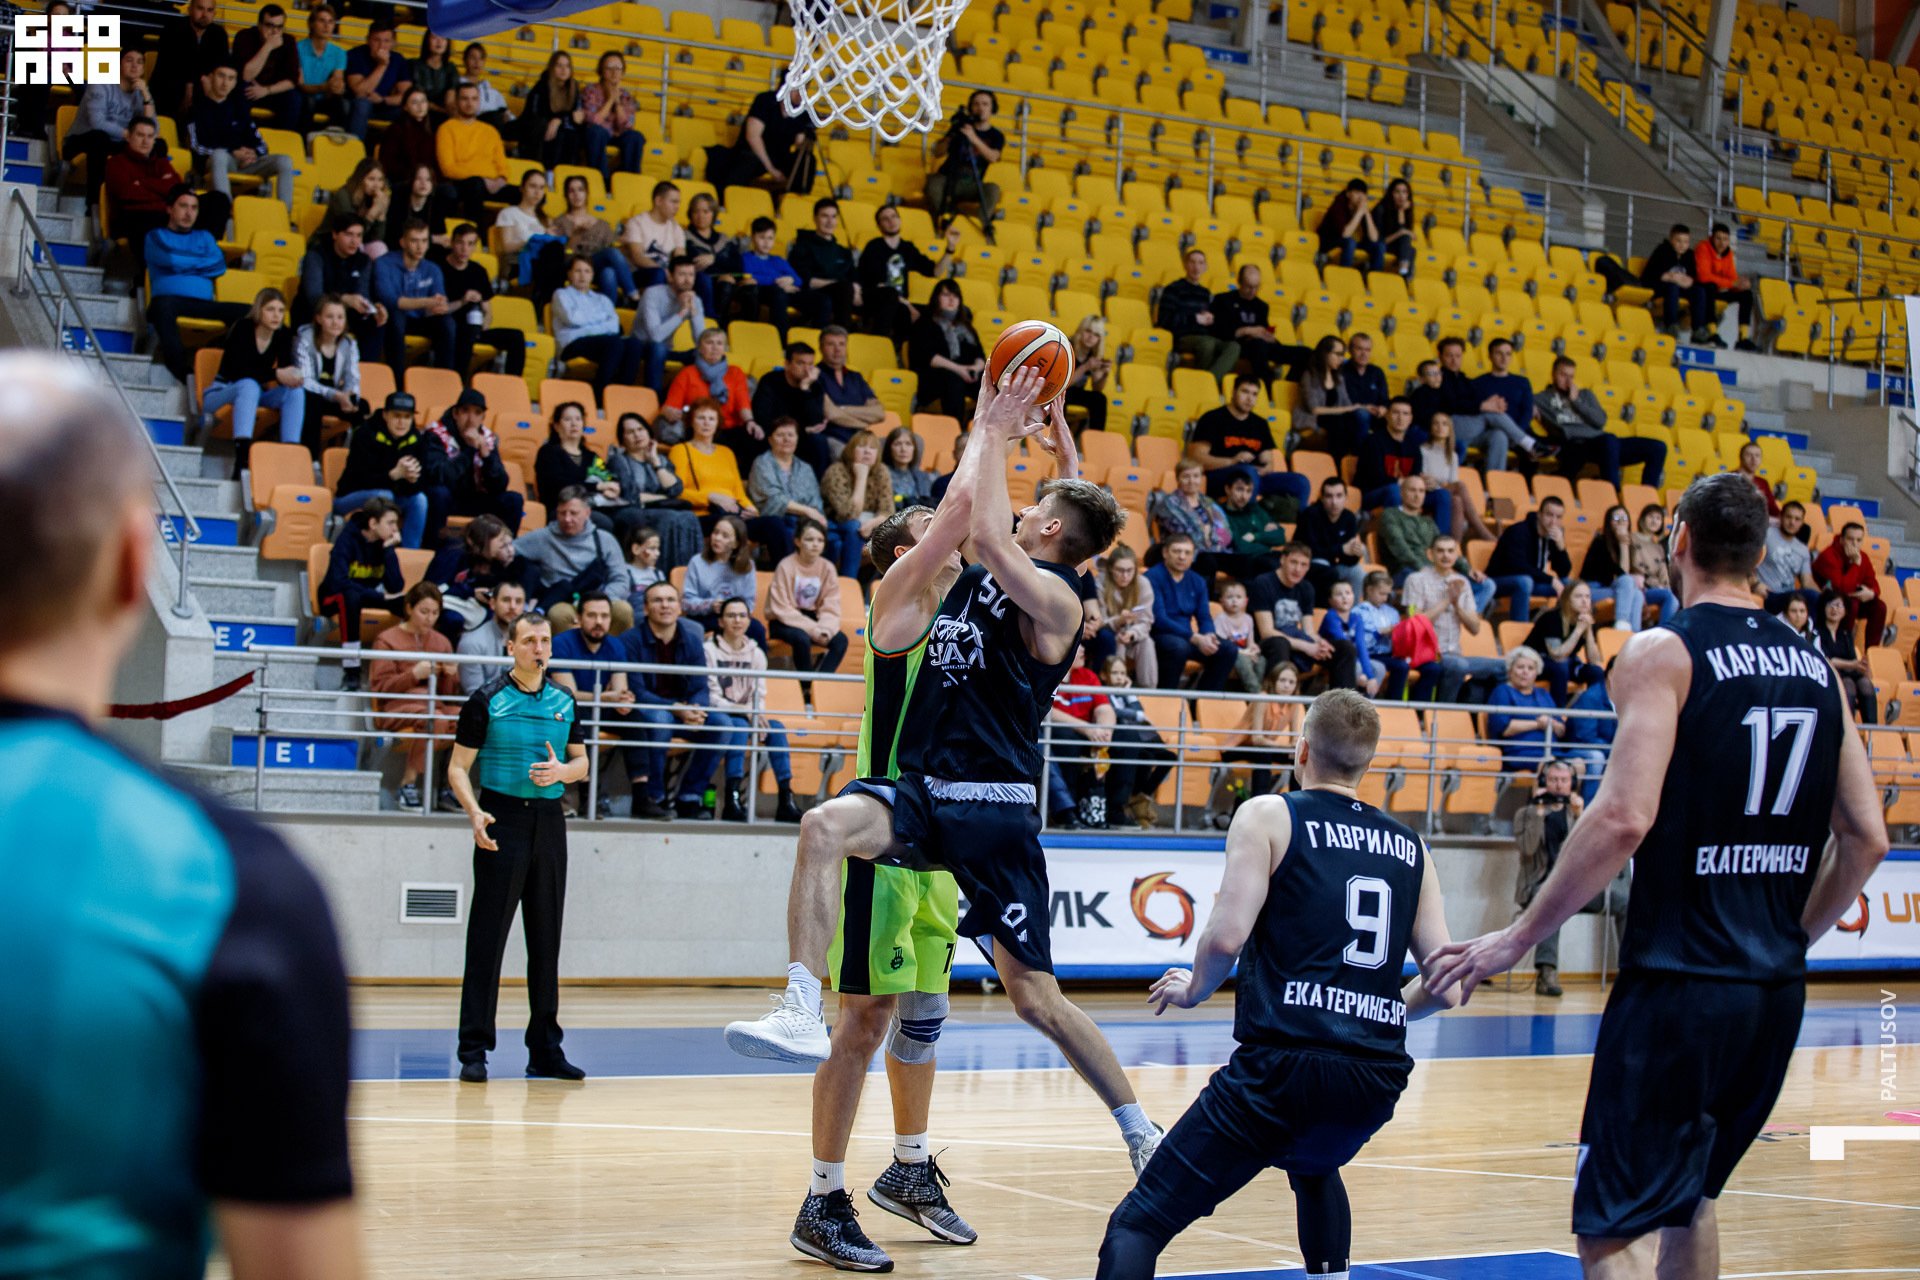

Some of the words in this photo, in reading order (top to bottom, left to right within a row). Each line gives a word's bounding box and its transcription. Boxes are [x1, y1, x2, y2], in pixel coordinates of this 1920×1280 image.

[215, 626, 231, 647] E
[242, 627, 256, 648] 2
[1706, 643, 1829, 688] КАРАУЛОВ
[276, 742, 291, 763] E
[305, 743, 315, 764] 1
[1741, 706, 1818, 816] 17
[1305, 820, 1417, 868] ГАВРИЛОВ
[1343, 874, 1393, 970] 9
